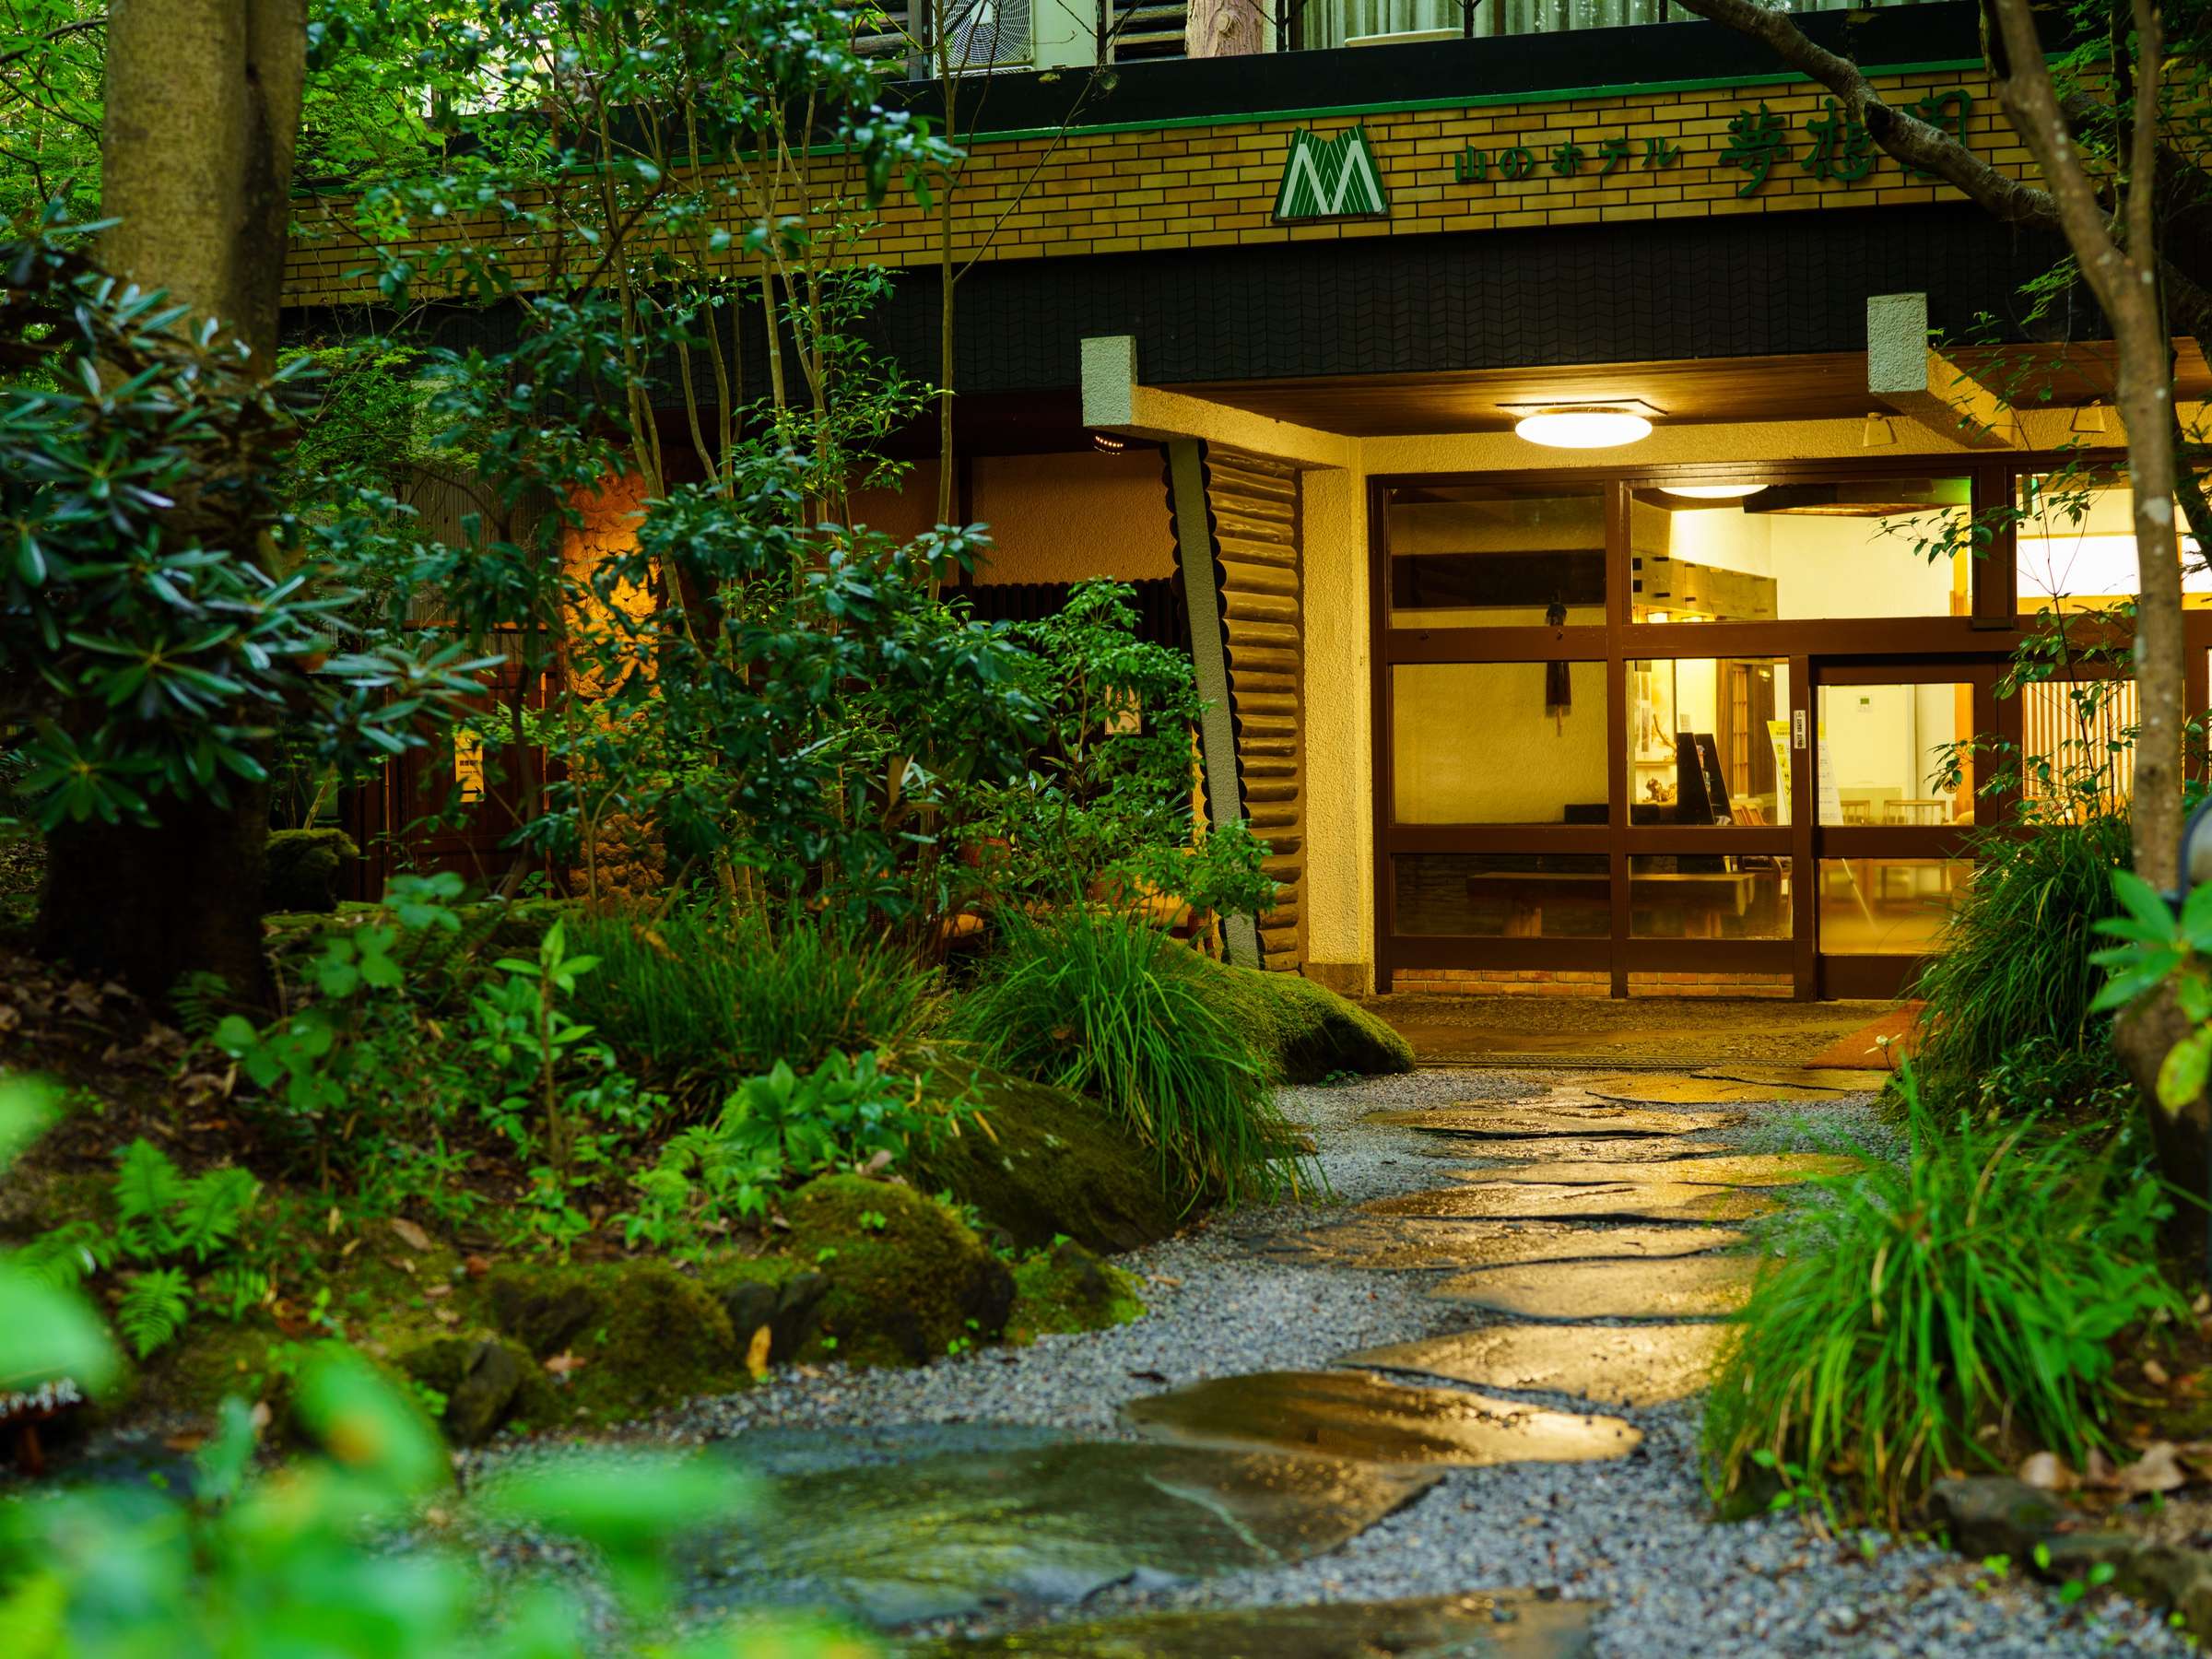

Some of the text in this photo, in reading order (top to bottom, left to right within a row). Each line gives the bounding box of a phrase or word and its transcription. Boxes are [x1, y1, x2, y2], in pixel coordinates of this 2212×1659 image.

[1454, 136, 1681, 182] 山のホテル
